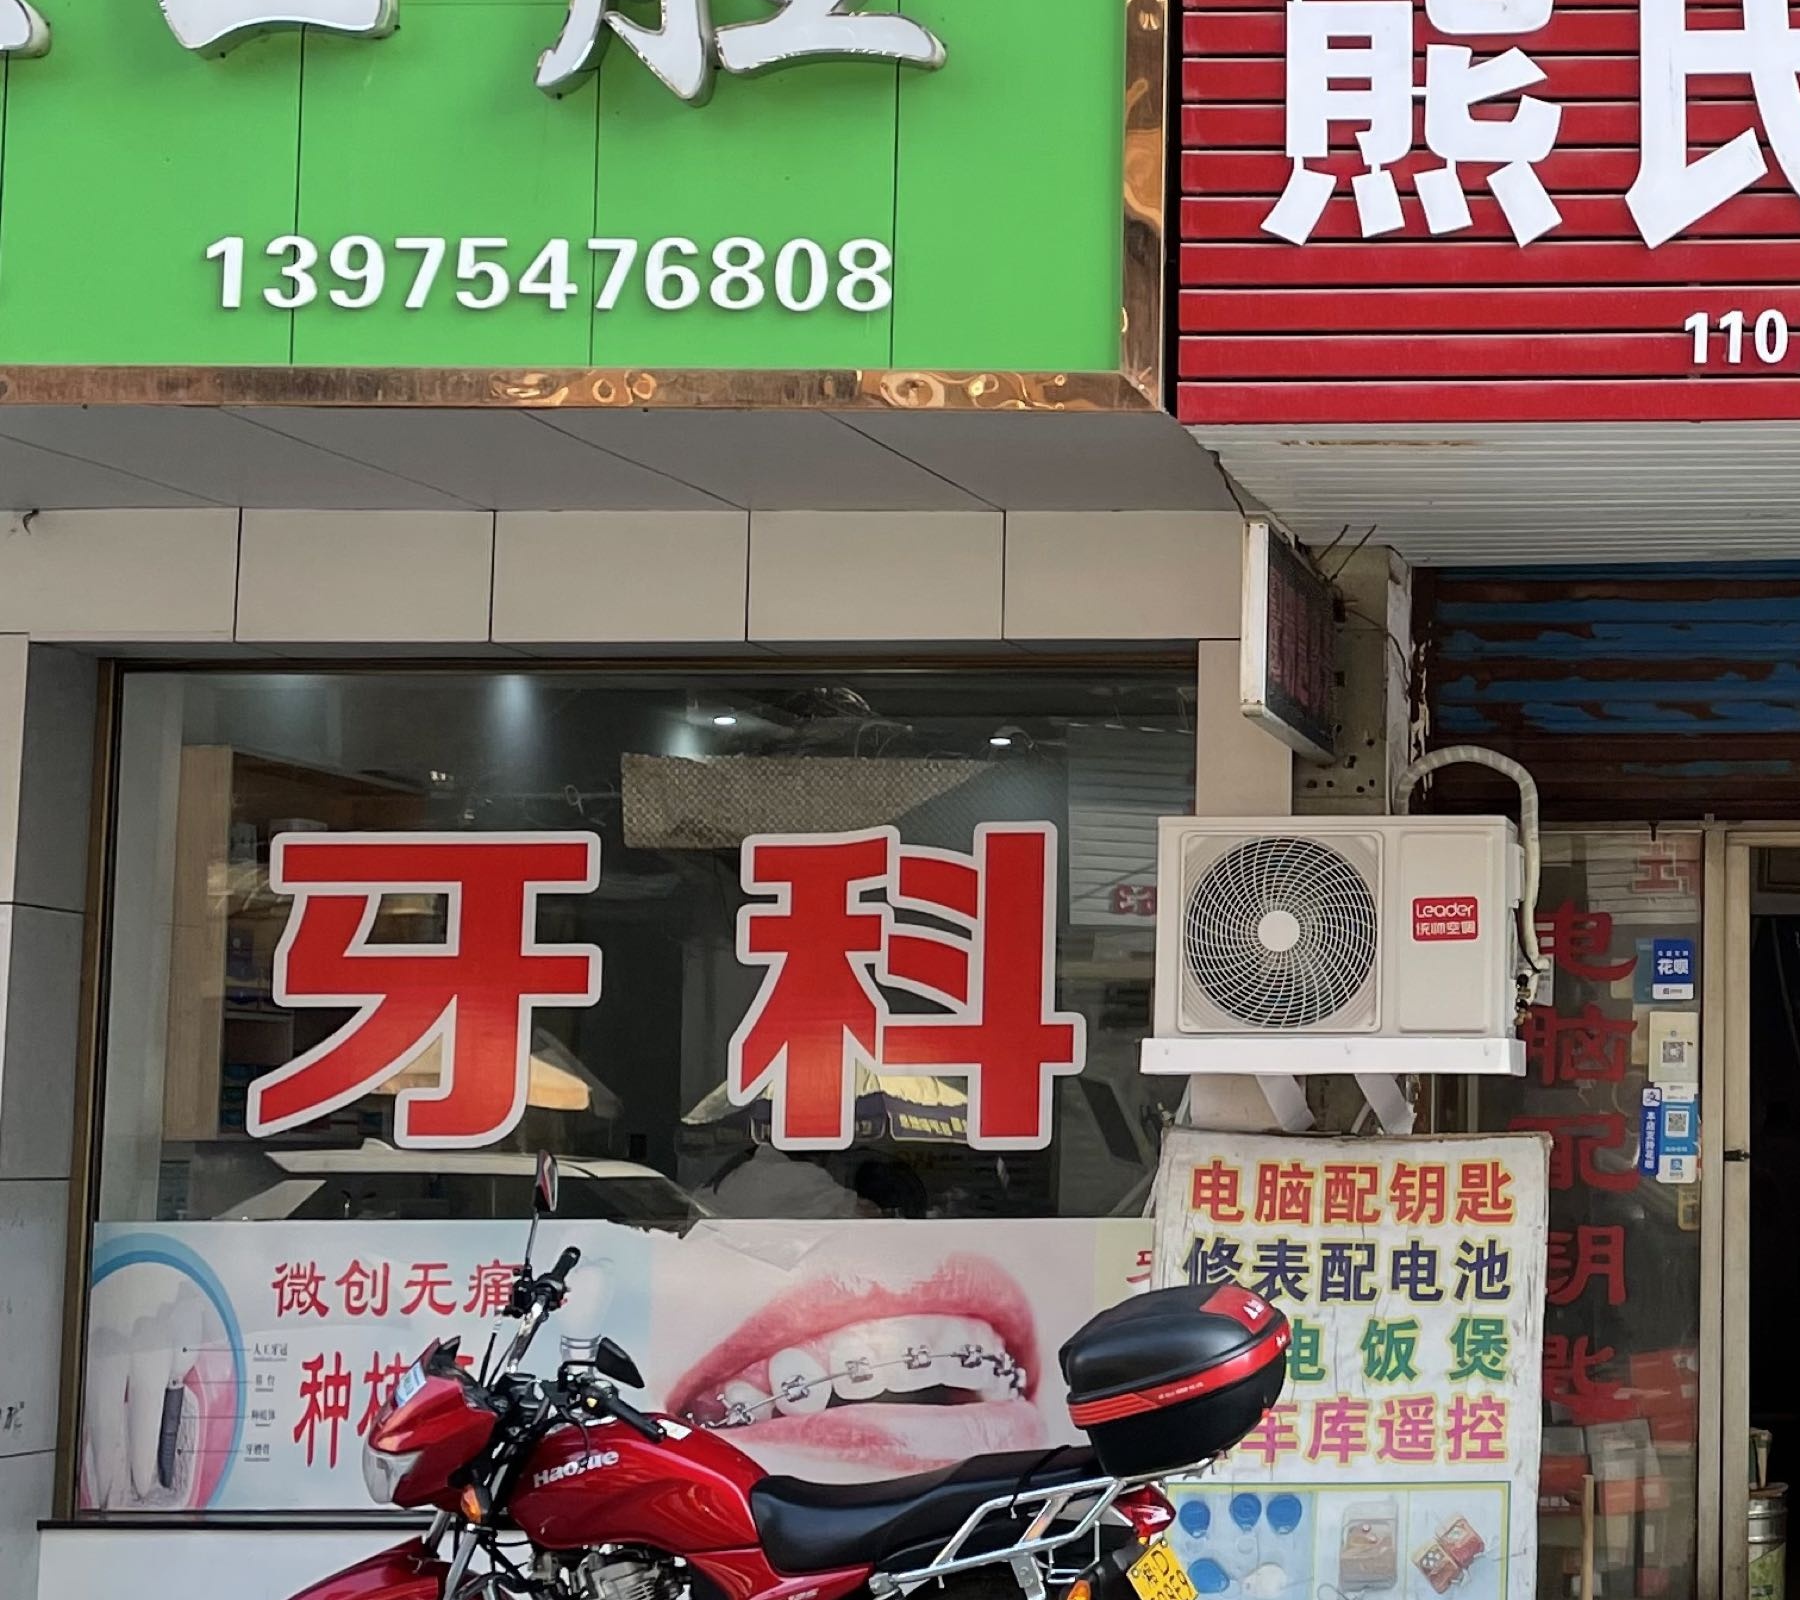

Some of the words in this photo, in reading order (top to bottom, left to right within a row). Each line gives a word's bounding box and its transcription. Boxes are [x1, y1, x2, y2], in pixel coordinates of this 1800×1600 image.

[205, 236, 893, 312] 13975476808
[1416, 902, 1474, 919] Leader
[247, 821, 1086, 1151] 牙科
[1657, 959, 1689, 976] 花呗
[1191, 1159, 1516, 1227] 电脑配钥匙
[272, 1259, 525, 1319] 微创无痛
[1182, 1238, 1511, 1303] 修表配电池
[1214, 1394, 1508, 1464] 车库遥控
